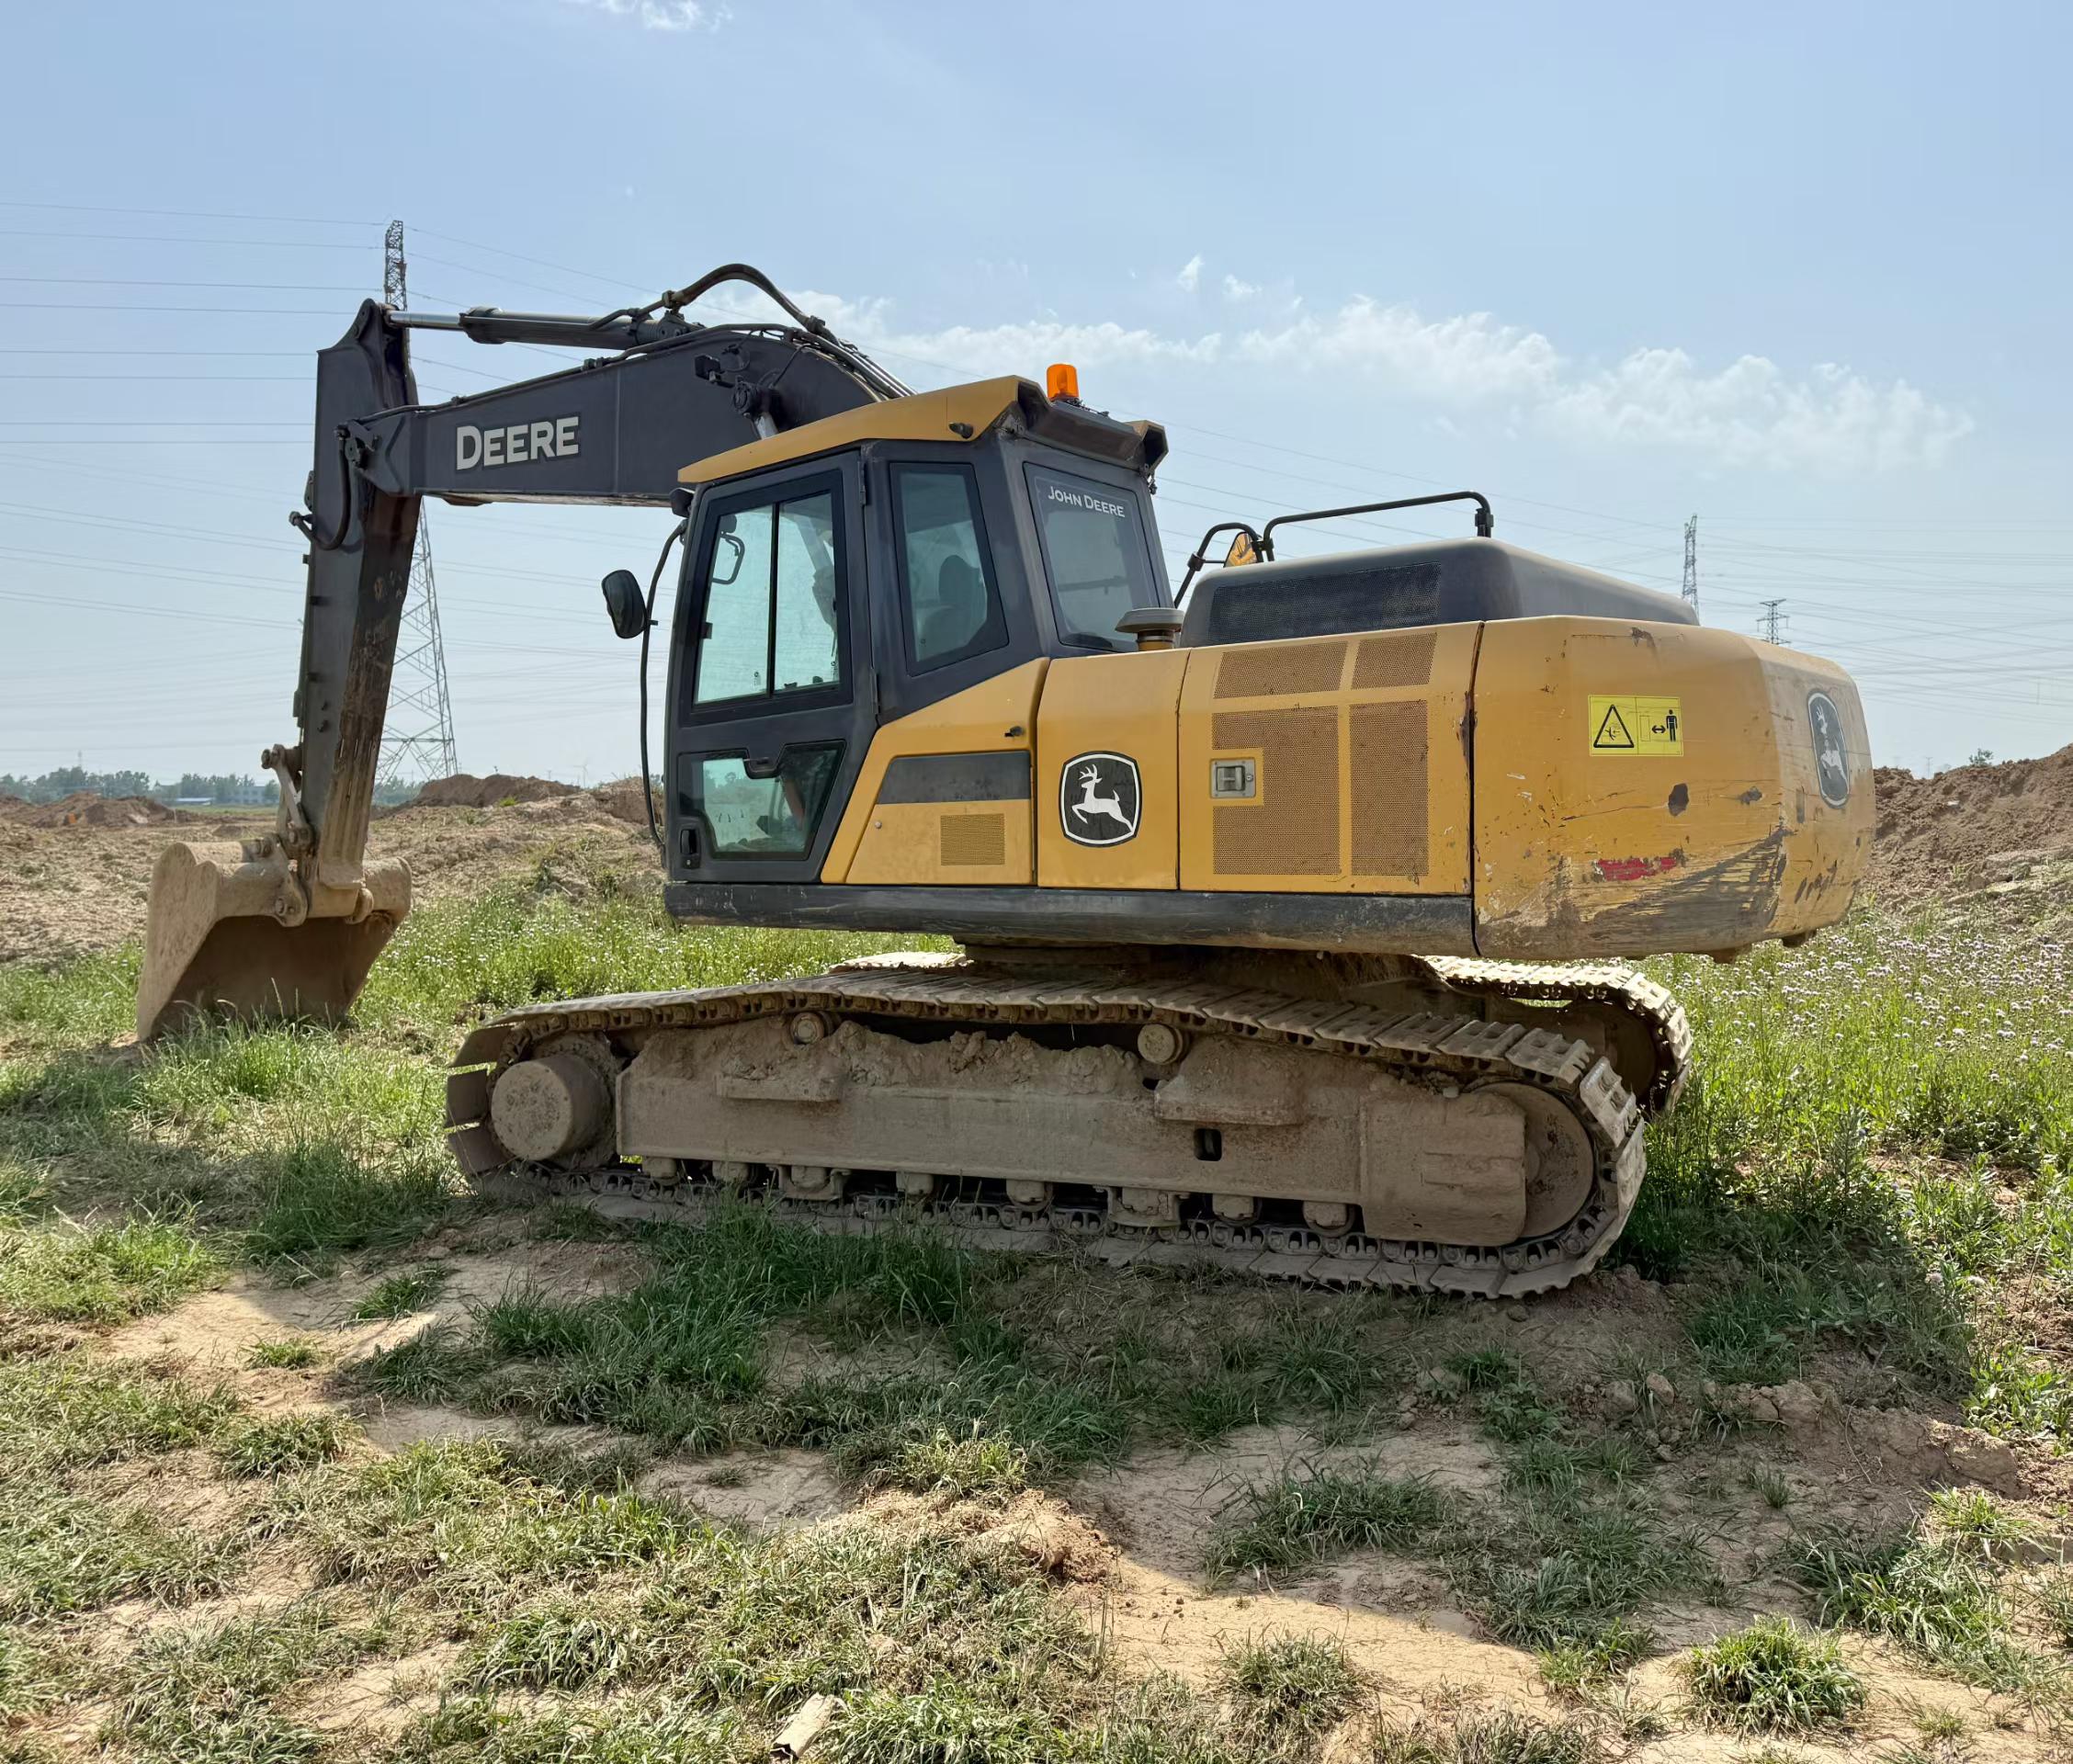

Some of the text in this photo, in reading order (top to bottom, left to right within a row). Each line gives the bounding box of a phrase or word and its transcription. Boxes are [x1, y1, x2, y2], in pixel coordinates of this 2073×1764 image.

[457, 416, 579, 470] DEERE
[1048, 486, 1126, 517] JOHN DEERE
